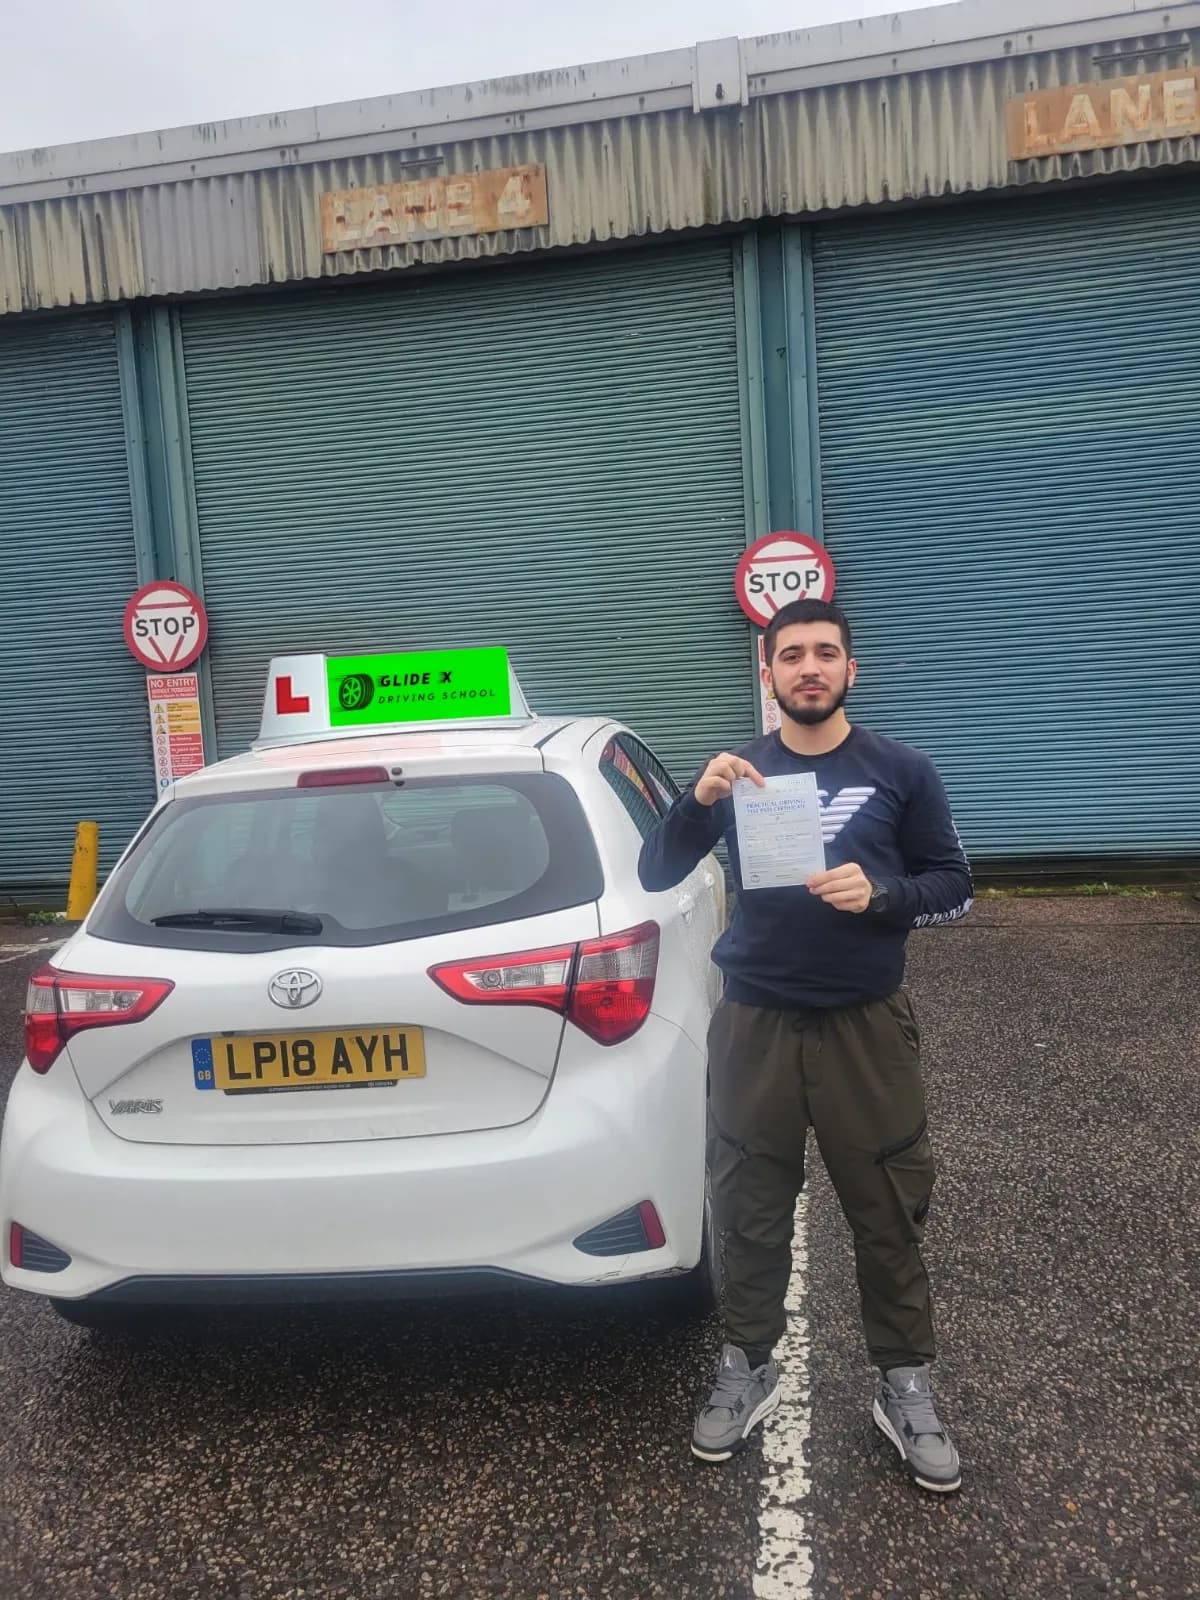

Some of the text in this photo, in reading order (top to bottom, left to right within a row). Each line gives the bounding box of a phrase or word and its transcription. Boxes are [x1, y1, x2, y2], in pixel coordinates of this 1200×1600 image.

[1024, 78, 1196, 149] LANE
[333, 176, 531, 240] LANE 4
[749, 570, 820, 593] STOP
[135, 616, 195, 637] STOP
[150, 677, 195, 689] NO ENTRY
[378, 671, 452, 687] GLIDE X
[275, 675, 310, 715] L
[378, 689, 496, 704] DRIVING SCHOOL
[226, 1034, 409, 1080] LP18 AYH
[198, 1070, 211, 1080] GB
[109, 1099, 162, 1114] YARIS
